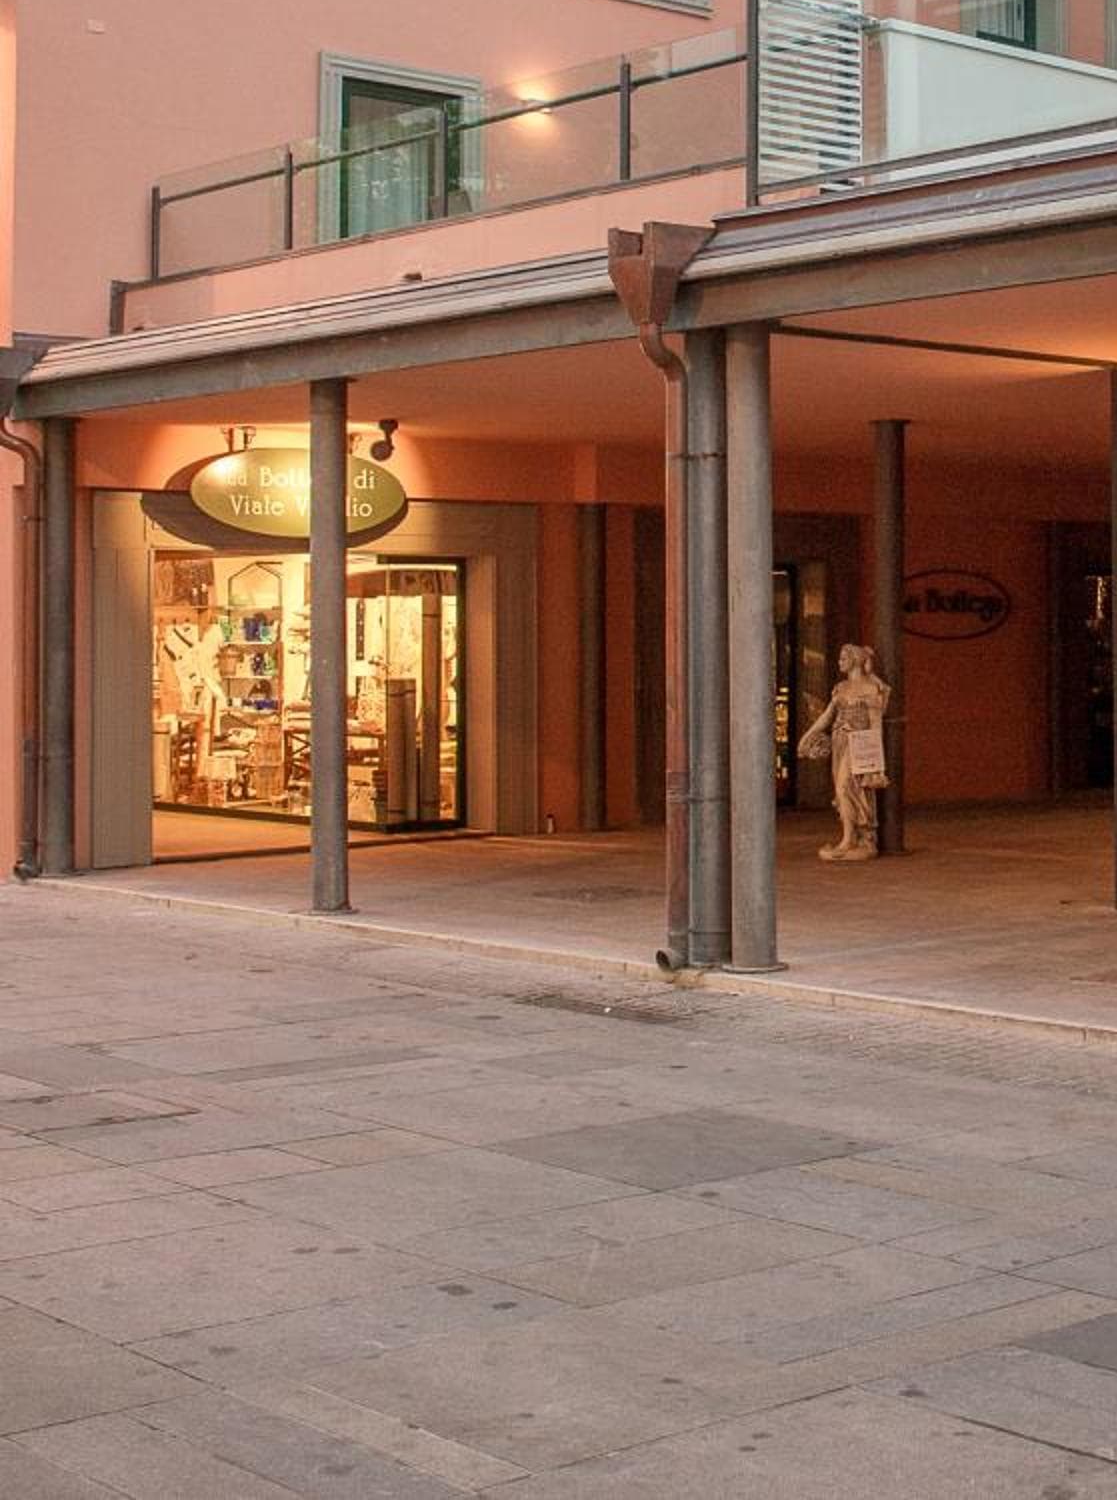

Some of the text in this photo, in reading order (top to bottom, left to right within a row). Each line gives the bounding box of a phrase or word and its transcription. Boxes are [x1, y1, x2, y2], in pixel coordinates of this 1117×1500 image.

[259, 466, 313, 488] Bott
[353, 467, 375, 490] di
[230, 494, 286, 517] Viale
